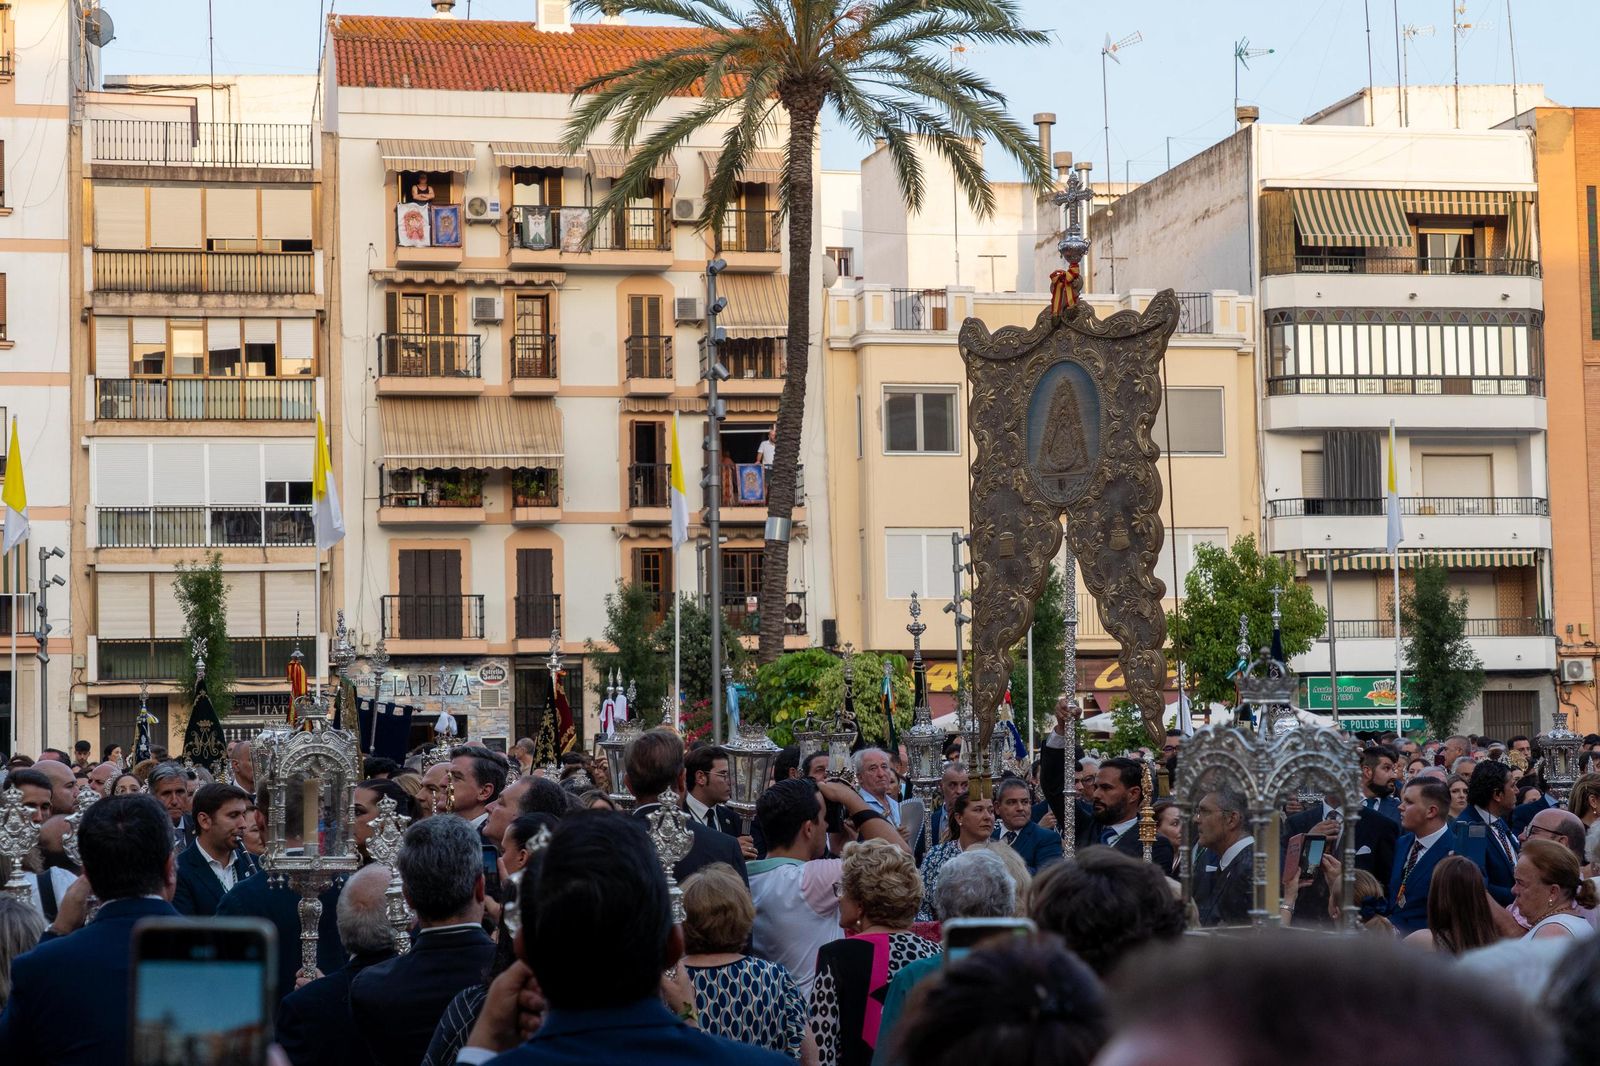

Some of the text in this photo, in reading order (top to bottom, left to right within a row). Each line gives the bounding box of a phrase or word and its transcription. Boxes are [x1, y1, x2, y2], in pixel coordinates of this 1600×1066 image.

[392, 675, 413, 697] LA
[262, 695, 288, 704] HUE
[261, 704, 288, 714] TAT
[1350, 719, 1379, 729] POLLOS
